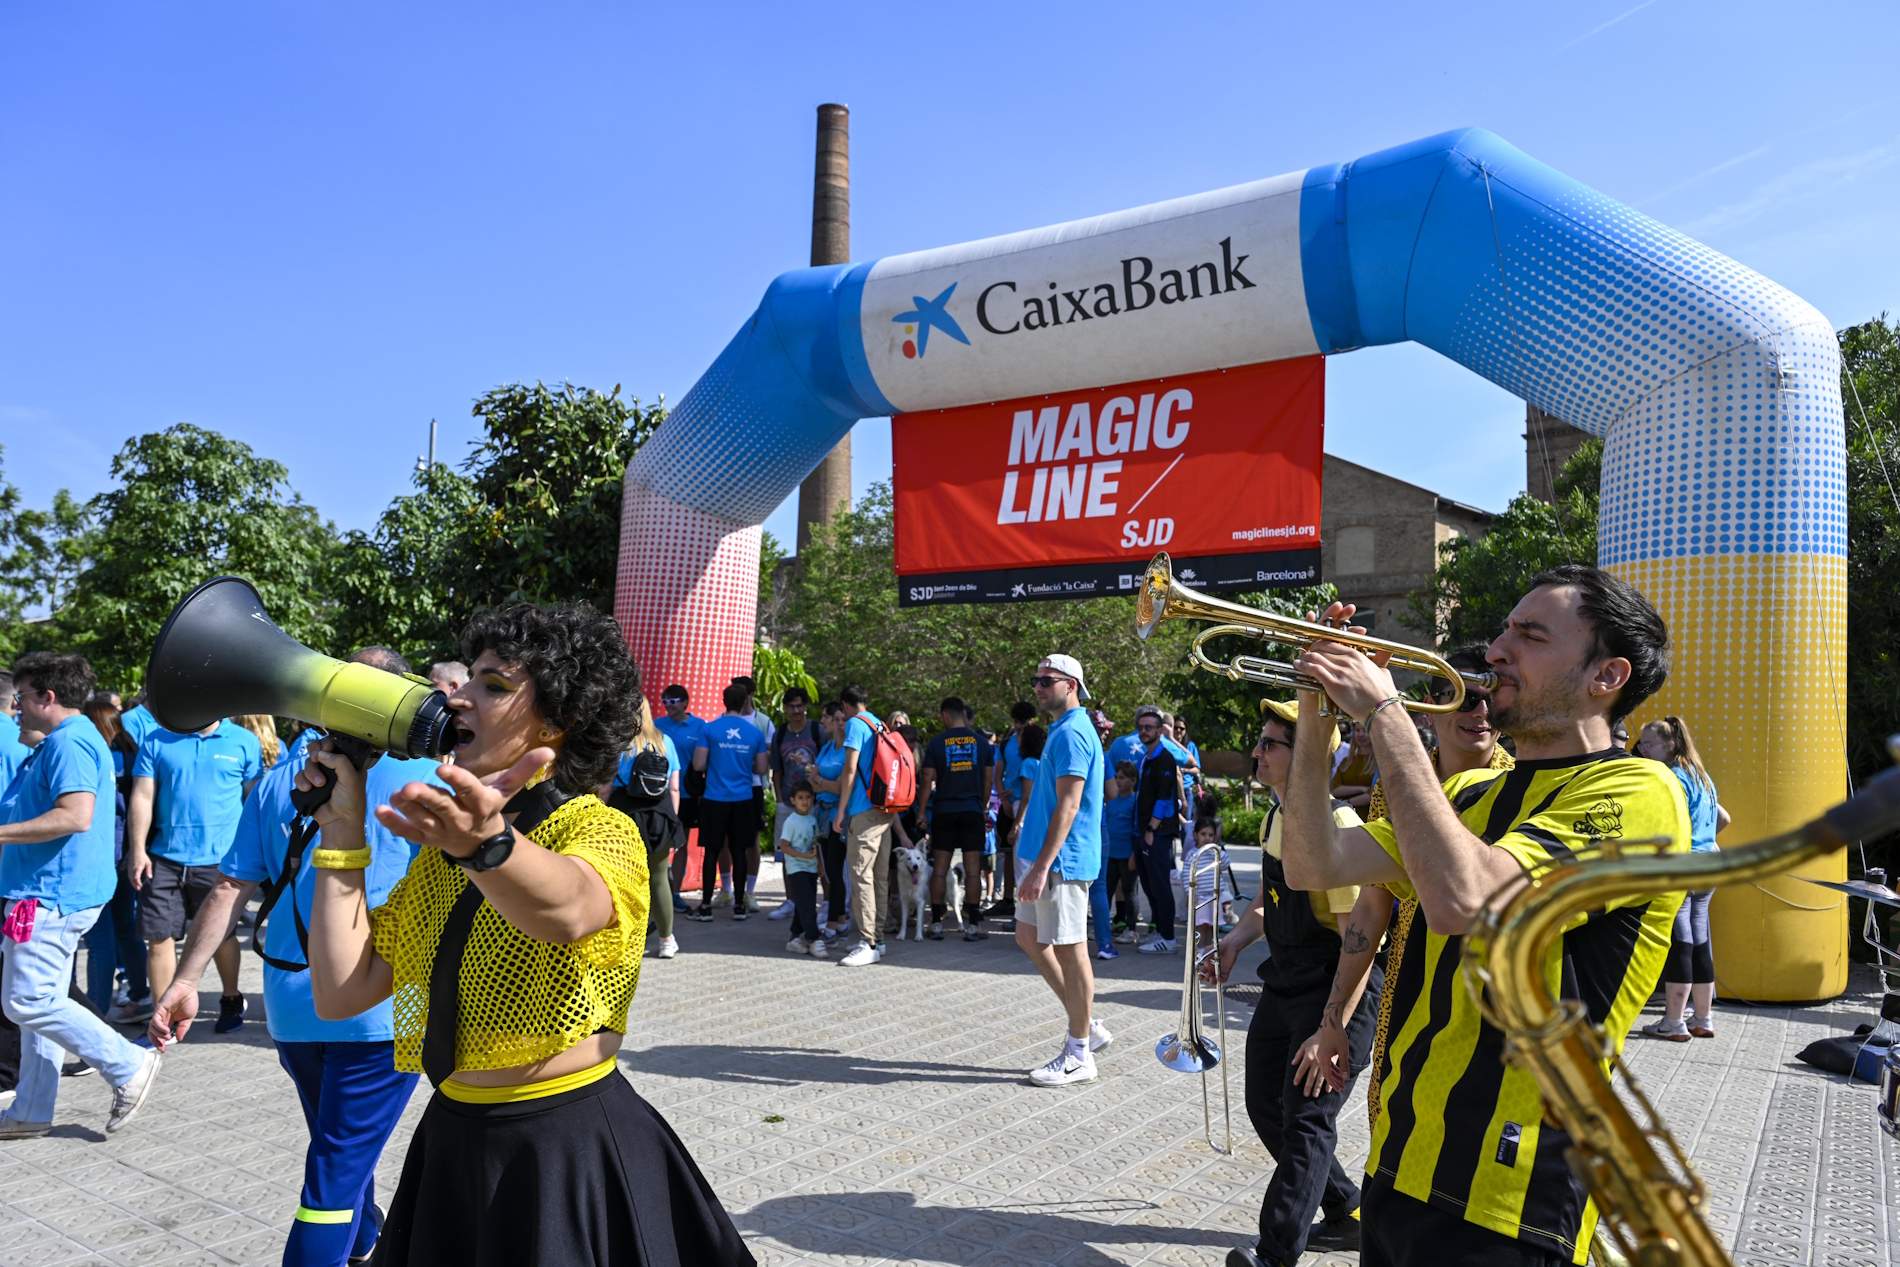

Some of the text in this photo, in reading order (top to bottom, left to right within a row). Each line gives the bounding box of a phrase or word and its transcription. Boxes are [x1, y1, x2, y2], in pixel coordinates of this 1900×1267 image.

[976, 236, 1257, 335] CaixaBank
[1007, 389, 1193, 465] MAGIC
[997, 460, 1123, 525] LINE
[1121, 518, 1175, 548] SJD
[1232, 525, 1315, 541] magiclinesjd.org
[1027, 582, 1062, 593] Fundació
[1257, 570, 1307, 581] Barcelona
[910, 586, 933, 600] SJD
[887, 760, 899, 800] HEAD
